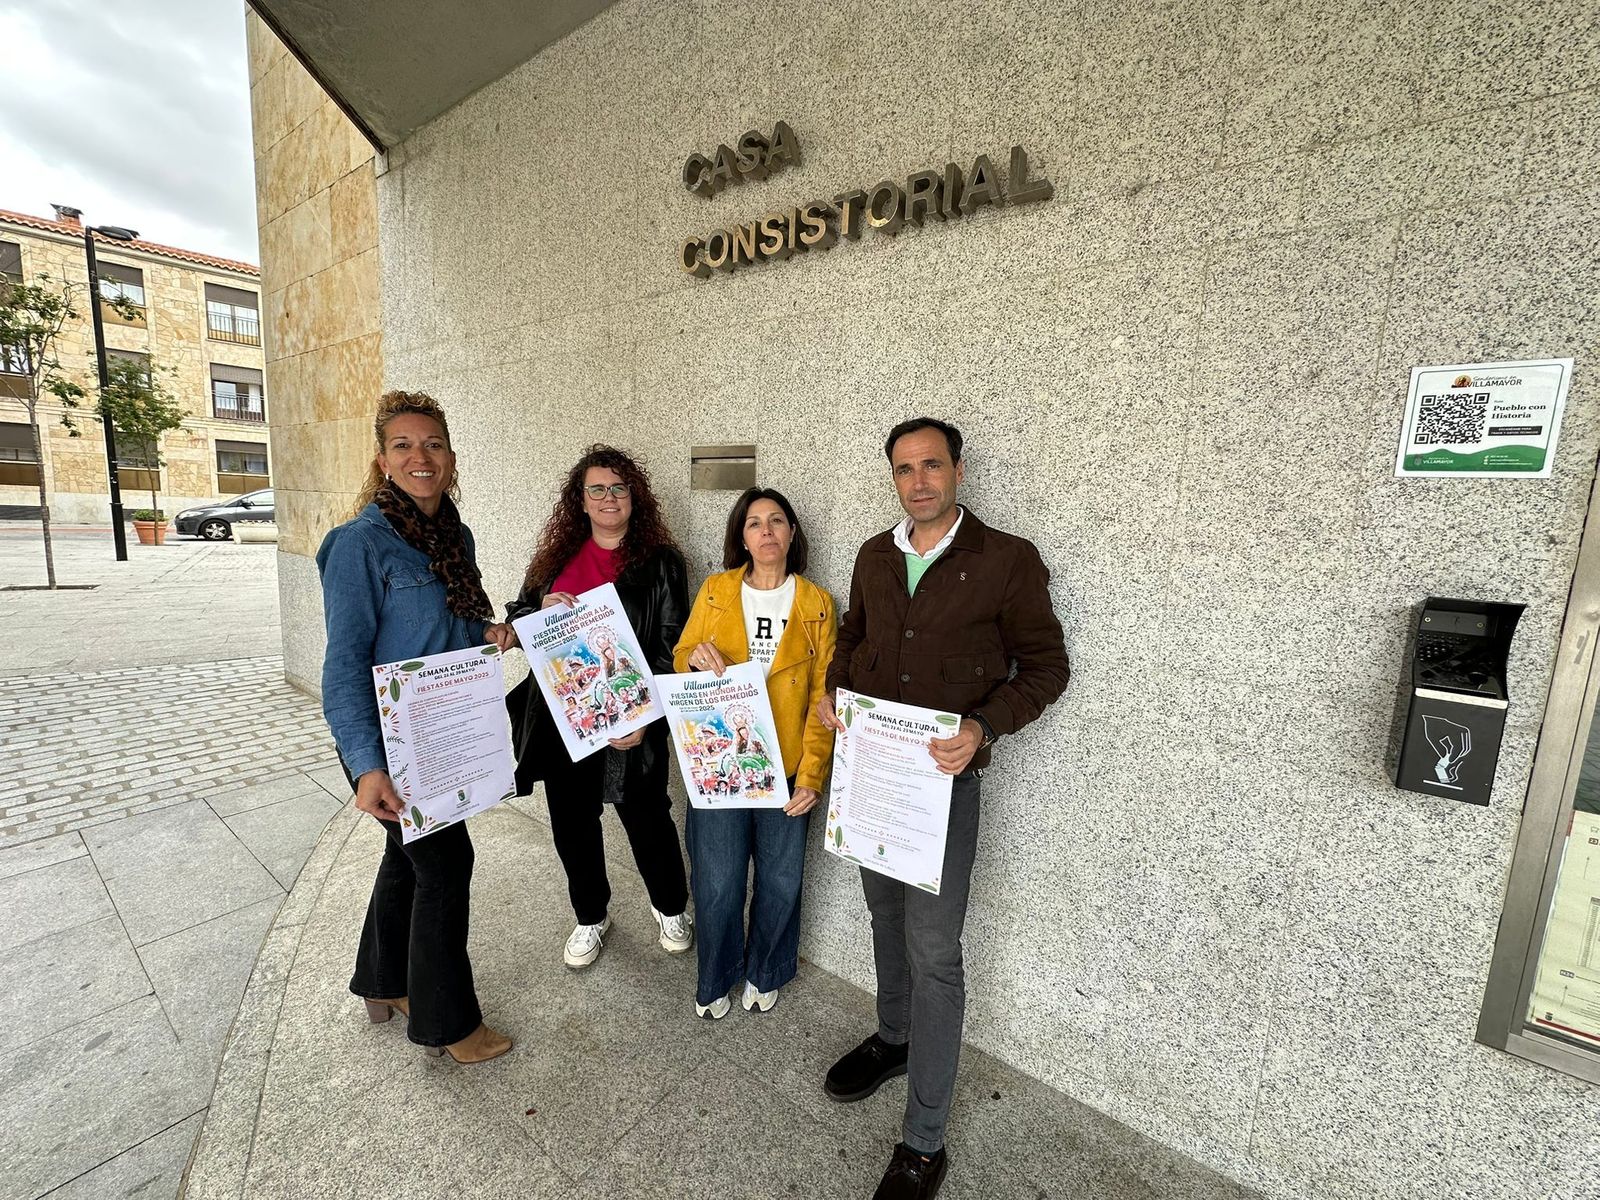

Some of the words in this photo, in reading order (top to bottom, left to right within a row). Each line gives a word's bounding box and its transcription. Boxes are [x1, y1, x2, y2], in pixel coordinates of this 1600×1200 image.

[682, 120, 801, 197] CASA
[678, 145, 1053, 278] CONSISTORIAL
[1468, 379, 1522, 388] VILLAMAYOR
[533, 625, 560, 641] FIESTAS
[560, 621, 569, 630] EN
[569, 611, 593, 625] HONOR
[600, 604, 608, 612] LA
[544, 604, 588, 627] Villamayor
[532, 635, 557, 650] VIRGEN
[557, 631, 566, 639] DE
[567, 625, 580, 635] LOS
[580, 609, 615, 629] REMEDIOS
[562, 633, 578, 644] 2025
[418, 667, 449, 679] SEMANA
[450, 658, 488, 672] CULTURAL
[417, 682, 444, 693] FIESTAS
[453, 675, 473, 684] MAYO
[474, 671, 489, 680] 2025
[671, 692, 698, 700] FIESTAS
[709, 686, 736, 697] HONOR
[743, 682, 753, 690] LA
[683, 678, 733, 691] Villamayor
[705, 696, 719, 704] LOS
[720, 688, 759, 702] REMEDIOS
[868, 712, 897, 725] SEMANA
[898, 719, 940, 734] CULTURAL
[908, 729, 924, 737] MAYO
[864, 726, 889, 737] FIESTAS
[899, 735, 920, 745] MAYO
